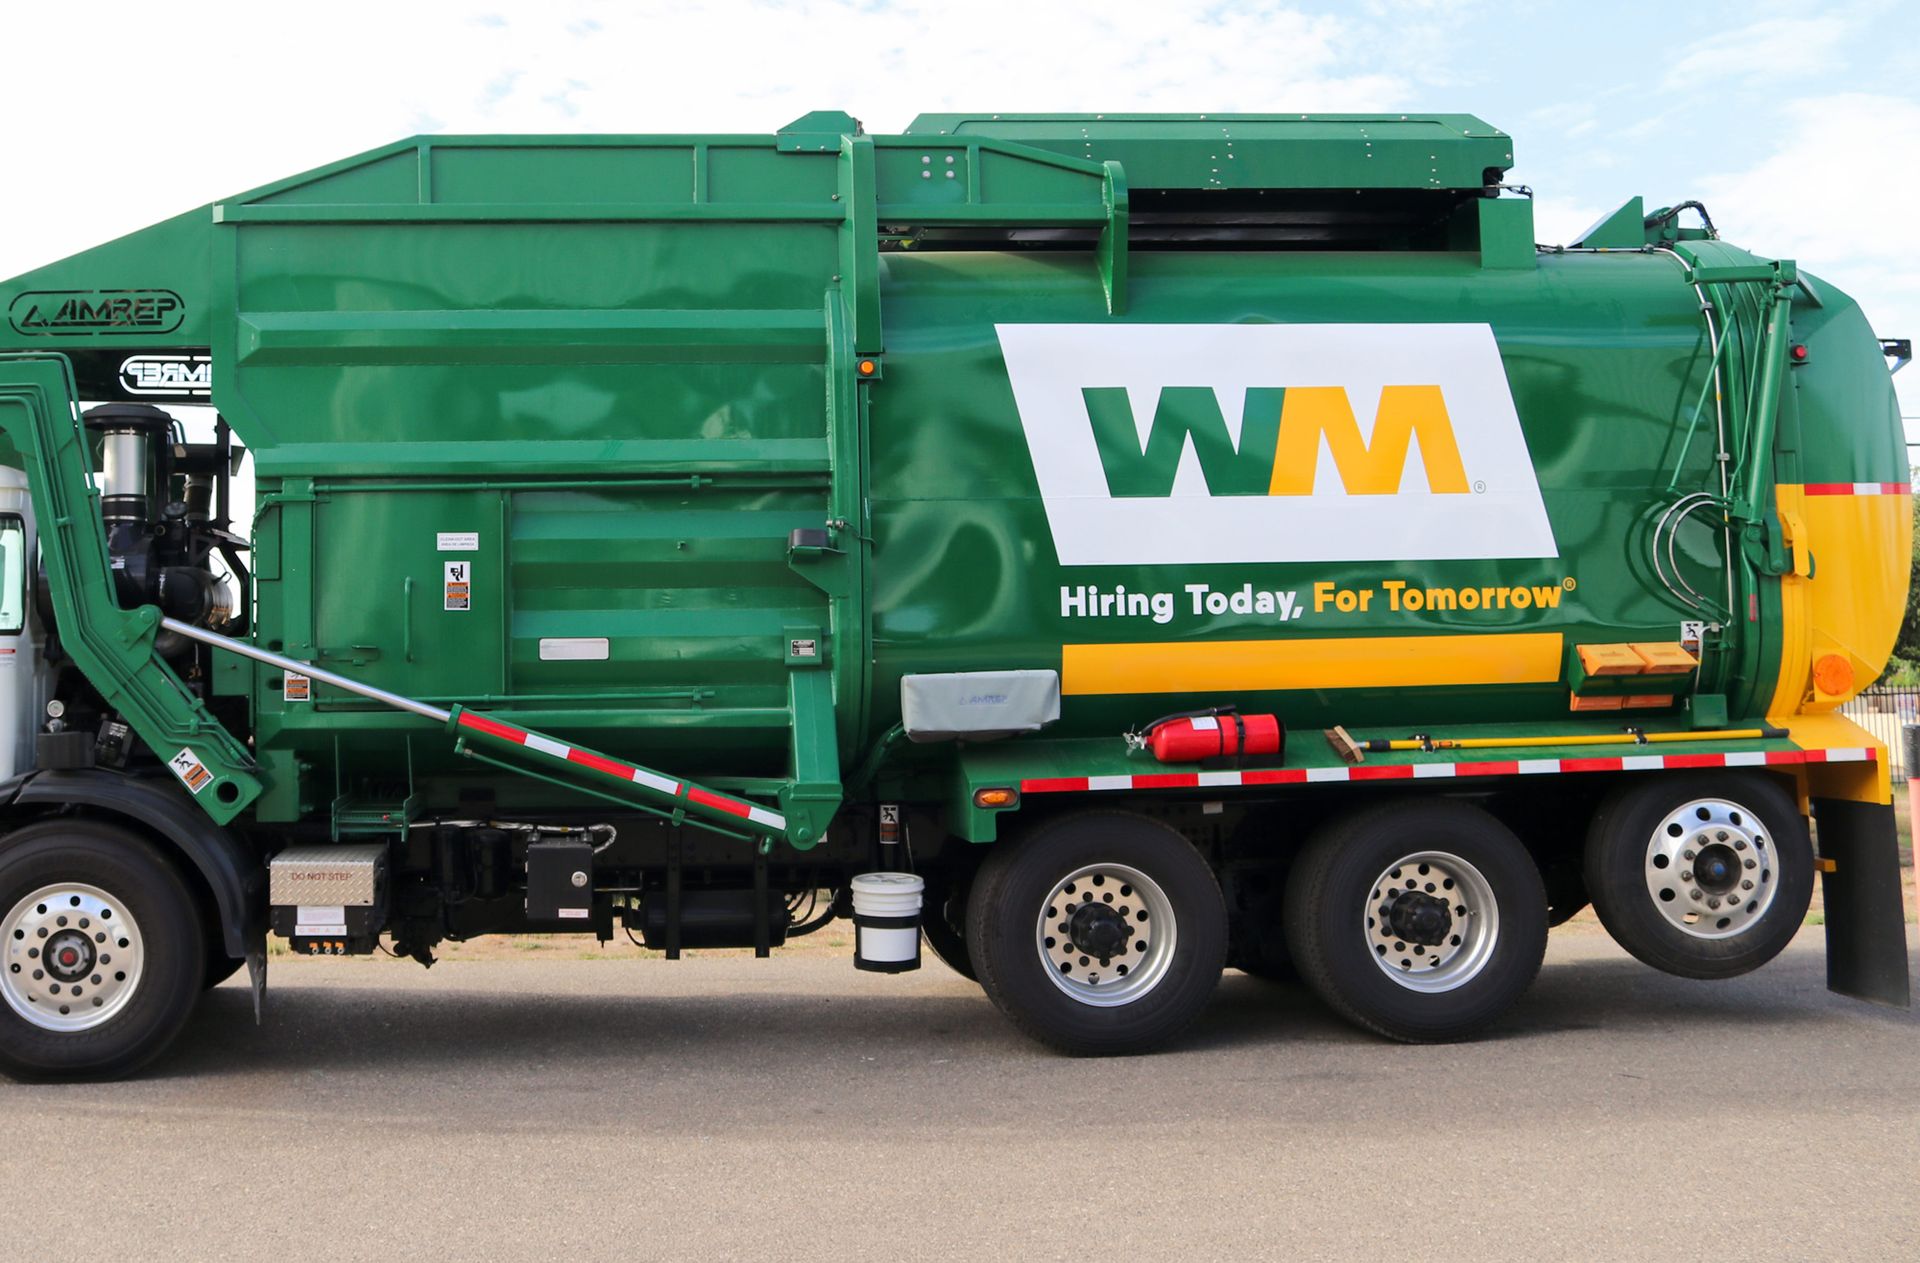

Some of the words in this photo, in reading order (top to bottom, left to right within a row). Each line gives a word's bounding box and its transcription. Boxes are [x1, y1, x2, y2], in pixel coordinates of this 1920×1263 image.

[50, 298, 177, 326] AMREP
[1060, 585, 1174, 624] Hiring
[1184, 583, 1304, 622] Today,
[1314, 581, 1373, 613] For
[292, 873, 305, 881] DO
[307, 872, 325, 881] NOT
[328, 872, 353, 881] STEP
